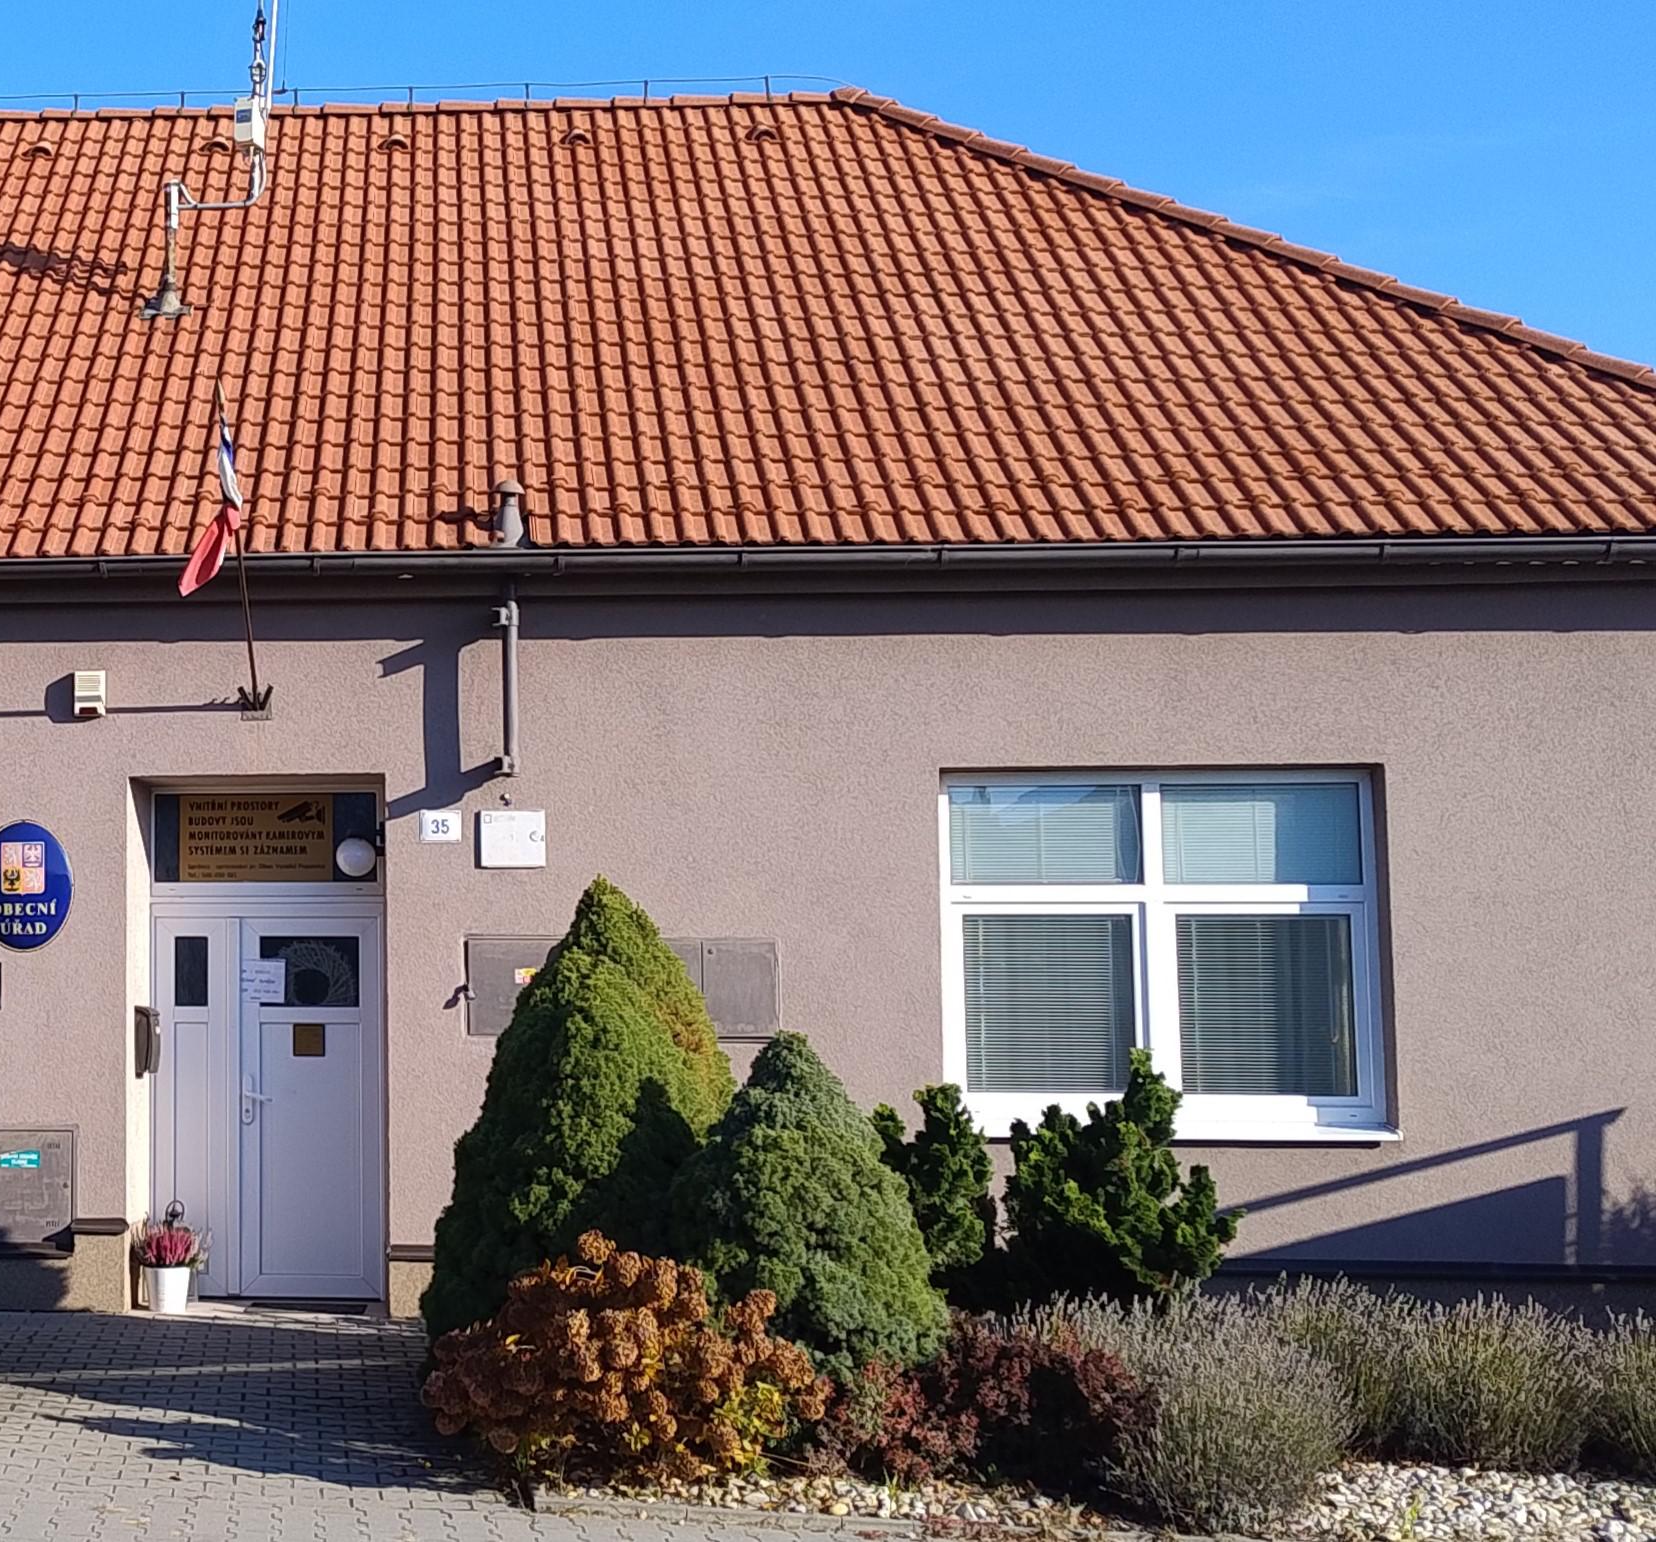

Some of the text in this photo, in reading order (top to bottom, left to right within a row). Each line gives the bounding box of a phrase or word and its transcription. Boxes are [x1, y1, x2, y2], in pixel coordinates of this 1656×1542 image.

[231, 801, 280, 811] PROSTORY
[189, 815, 254, 826] BUDOVY JSOU
[430, 819, 450, 835] 35
[189, 829, 263, 841] MONITOROVÁNY
[188, 844, 308, 856] SYSTÉMEM SE ZÁZNAMEM
[0, 920, 47, 935] ÚŘAD
